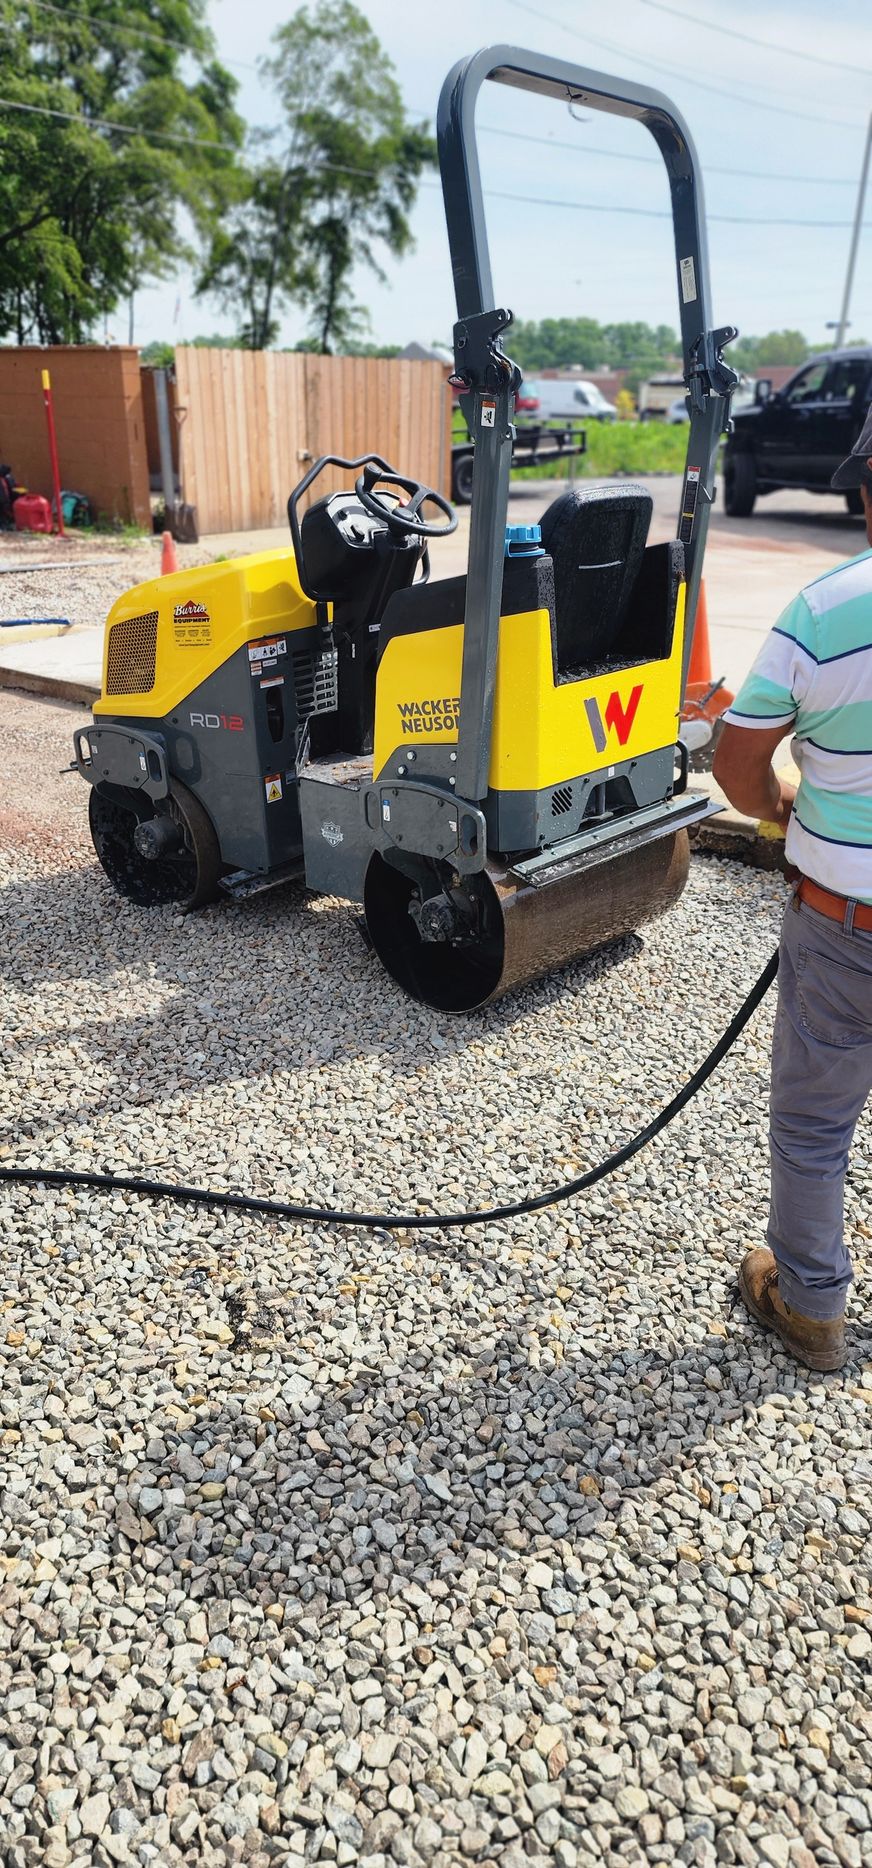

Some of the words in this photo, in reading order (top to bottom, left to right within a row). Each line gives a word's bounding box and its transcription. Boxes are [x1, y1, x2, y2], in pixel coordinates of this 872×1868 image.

[174, 602, 207, 616] Burris
[397, 698, 461, 718] WACKER
[190, 712, 244, 731] RD12
